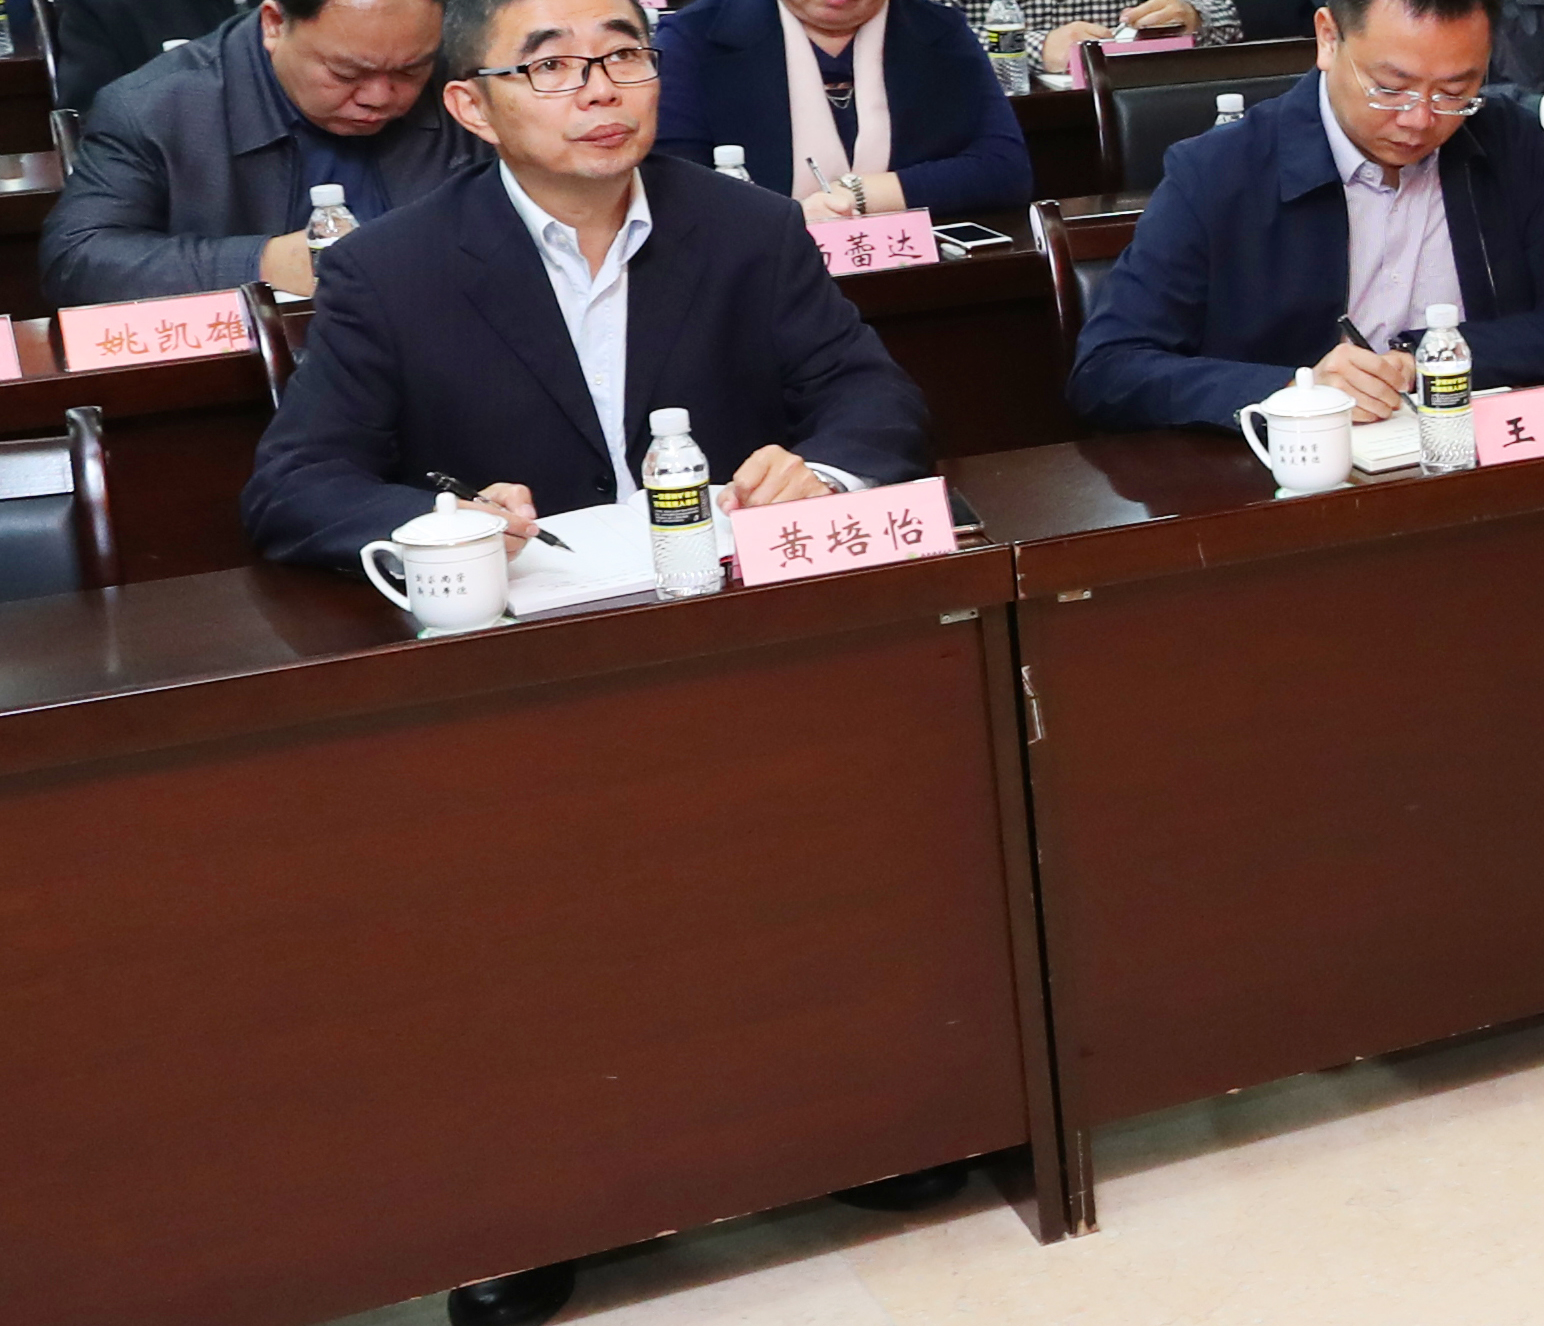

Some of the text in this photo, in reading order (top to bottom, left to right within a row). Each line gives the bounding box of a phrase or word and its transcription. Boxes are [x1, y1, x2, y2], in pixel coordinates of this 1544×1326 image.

[95, 310, 248, 356] 姚凯雄
[769, 508, 924, 568] 黄培怡
